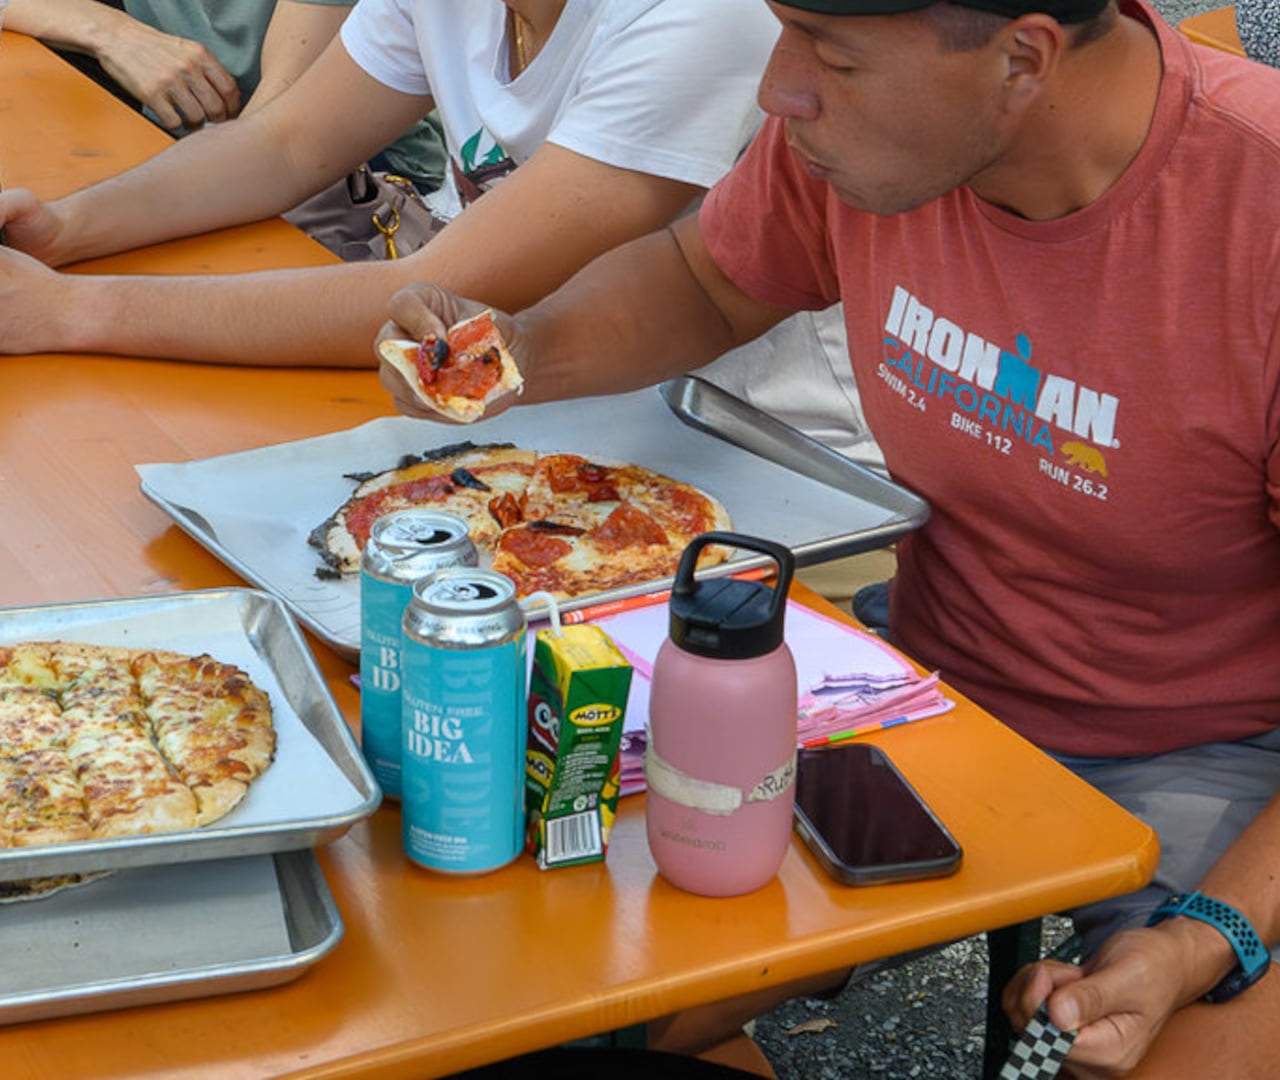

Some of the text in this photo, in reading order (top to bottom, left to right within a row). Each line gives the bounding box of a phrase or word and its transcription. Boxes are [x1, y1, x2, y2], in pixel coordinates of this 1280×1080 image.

[876, 361, 928, 413] SWIM 2.4
[884, 284, 1120, 449] IRONMAN
[882, 336, 1055, 456] CALIFORNIA
[949, 411, 1013, 456] BIKE 112
[1037, 457, 1109, 501] RUN 26.2
[372, 664, 401, 692] ID
[407, 728, 474, 764] IDEA
[414, 709, 464, 741] BIG
